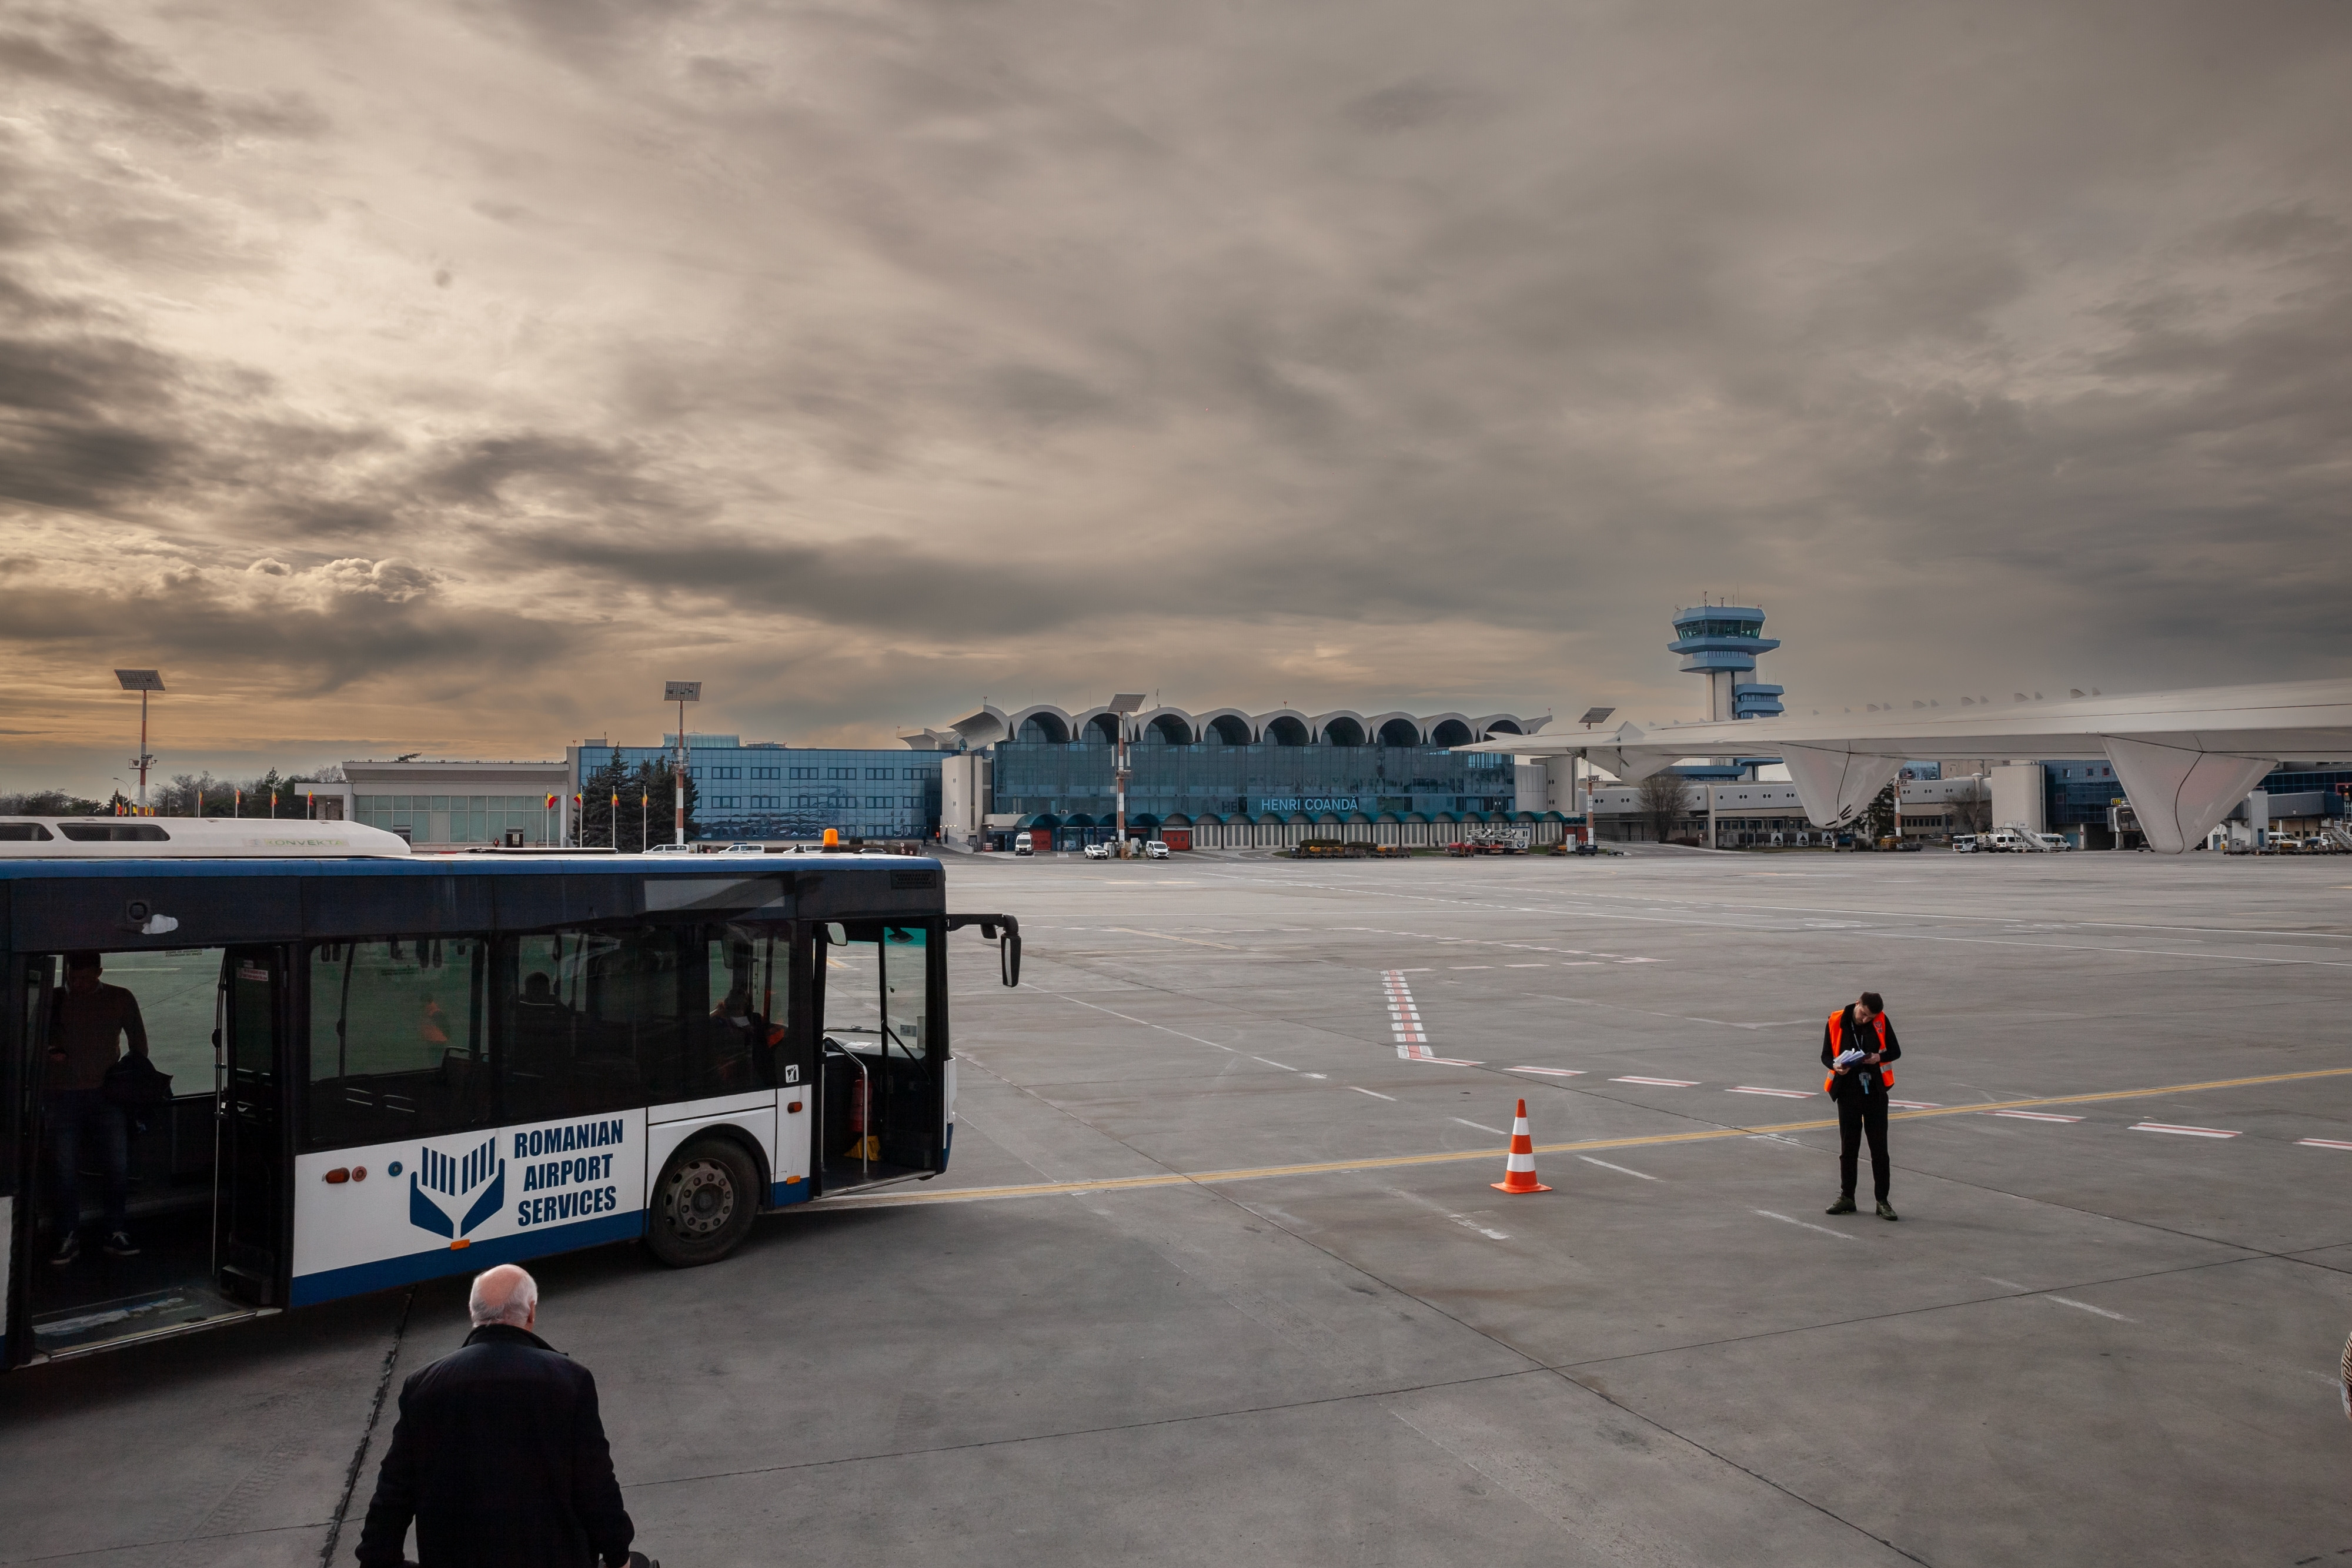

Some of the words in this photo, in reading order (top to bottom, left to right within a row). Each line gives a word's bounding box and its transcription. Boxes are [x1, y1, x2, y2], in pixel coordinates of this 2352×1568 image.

[1261, 799, 1300, 810] HENRI
[1305, 796, 1358, 810] COANDĂ
[514, 1119, 623, 1159] ROMANIAN
[523, 1153, 613, 1192] AIRPORT
[517, 1185, 616, 1227] SERVICES
